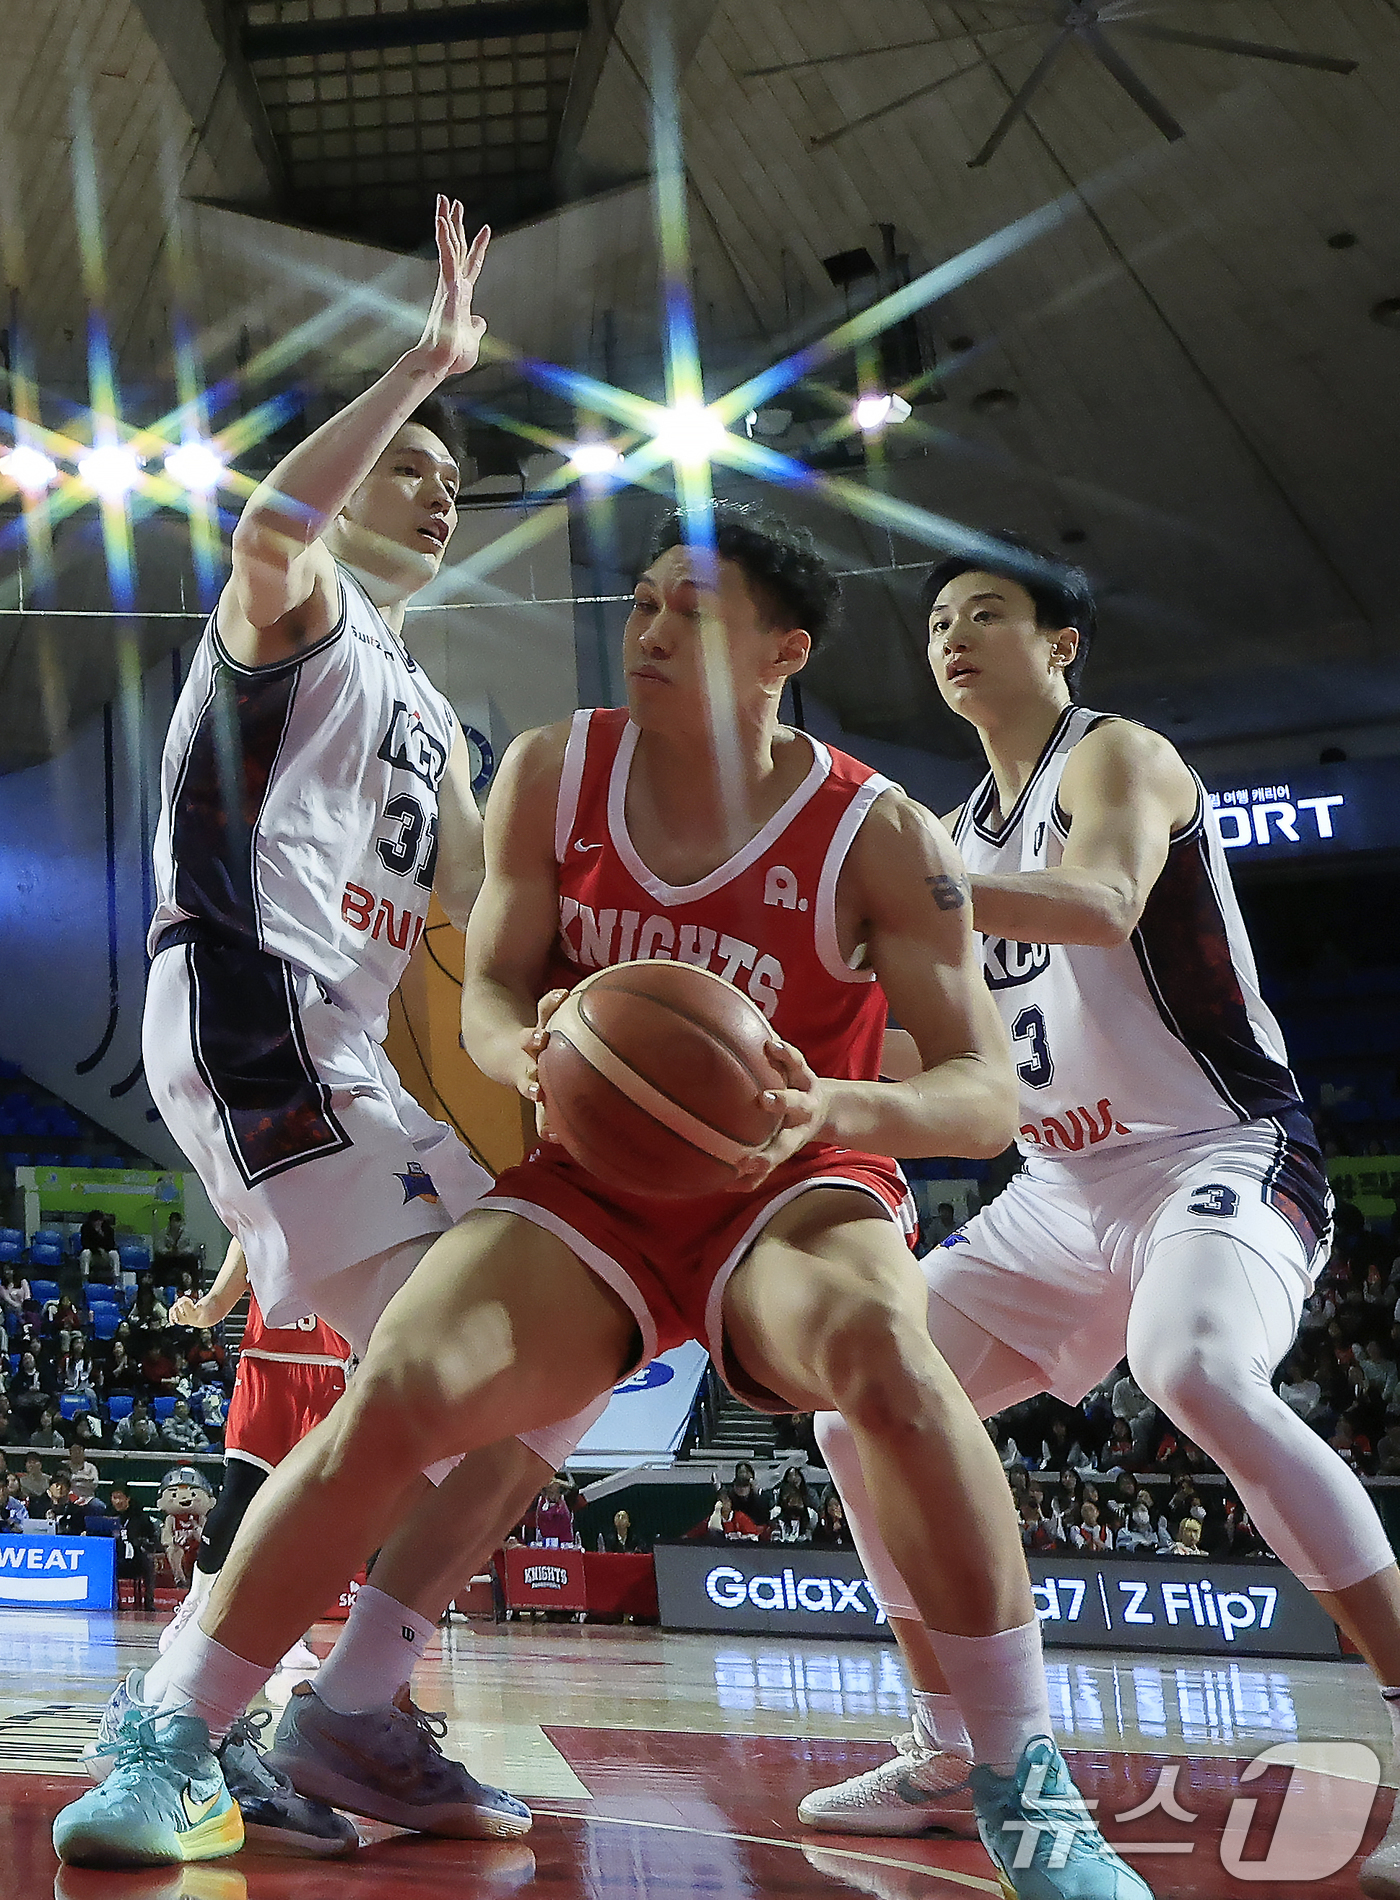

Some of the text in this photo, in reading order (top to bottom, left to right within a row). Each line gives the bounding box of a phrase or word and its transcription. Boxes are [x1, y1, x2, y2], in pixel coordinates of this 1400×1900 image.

[1223, 788, 1249, 805] 여행
[1251, 784, 1290, 802] 캐리어
[375, 792, 438, 893] 31
[559, 894, 785, 1020] KNIGHTS
[1011, 1003, 1055, 1091] 3
[1186, 1182, 1241, 1219] 3
[524, 1565, 568, 1585] KNIGHTS
[705, 1565, 888, 1625] Galaxy
[1118, 1581, 1155, 1624] Z
[1160, 1579, 1278, 1641] Flip7
